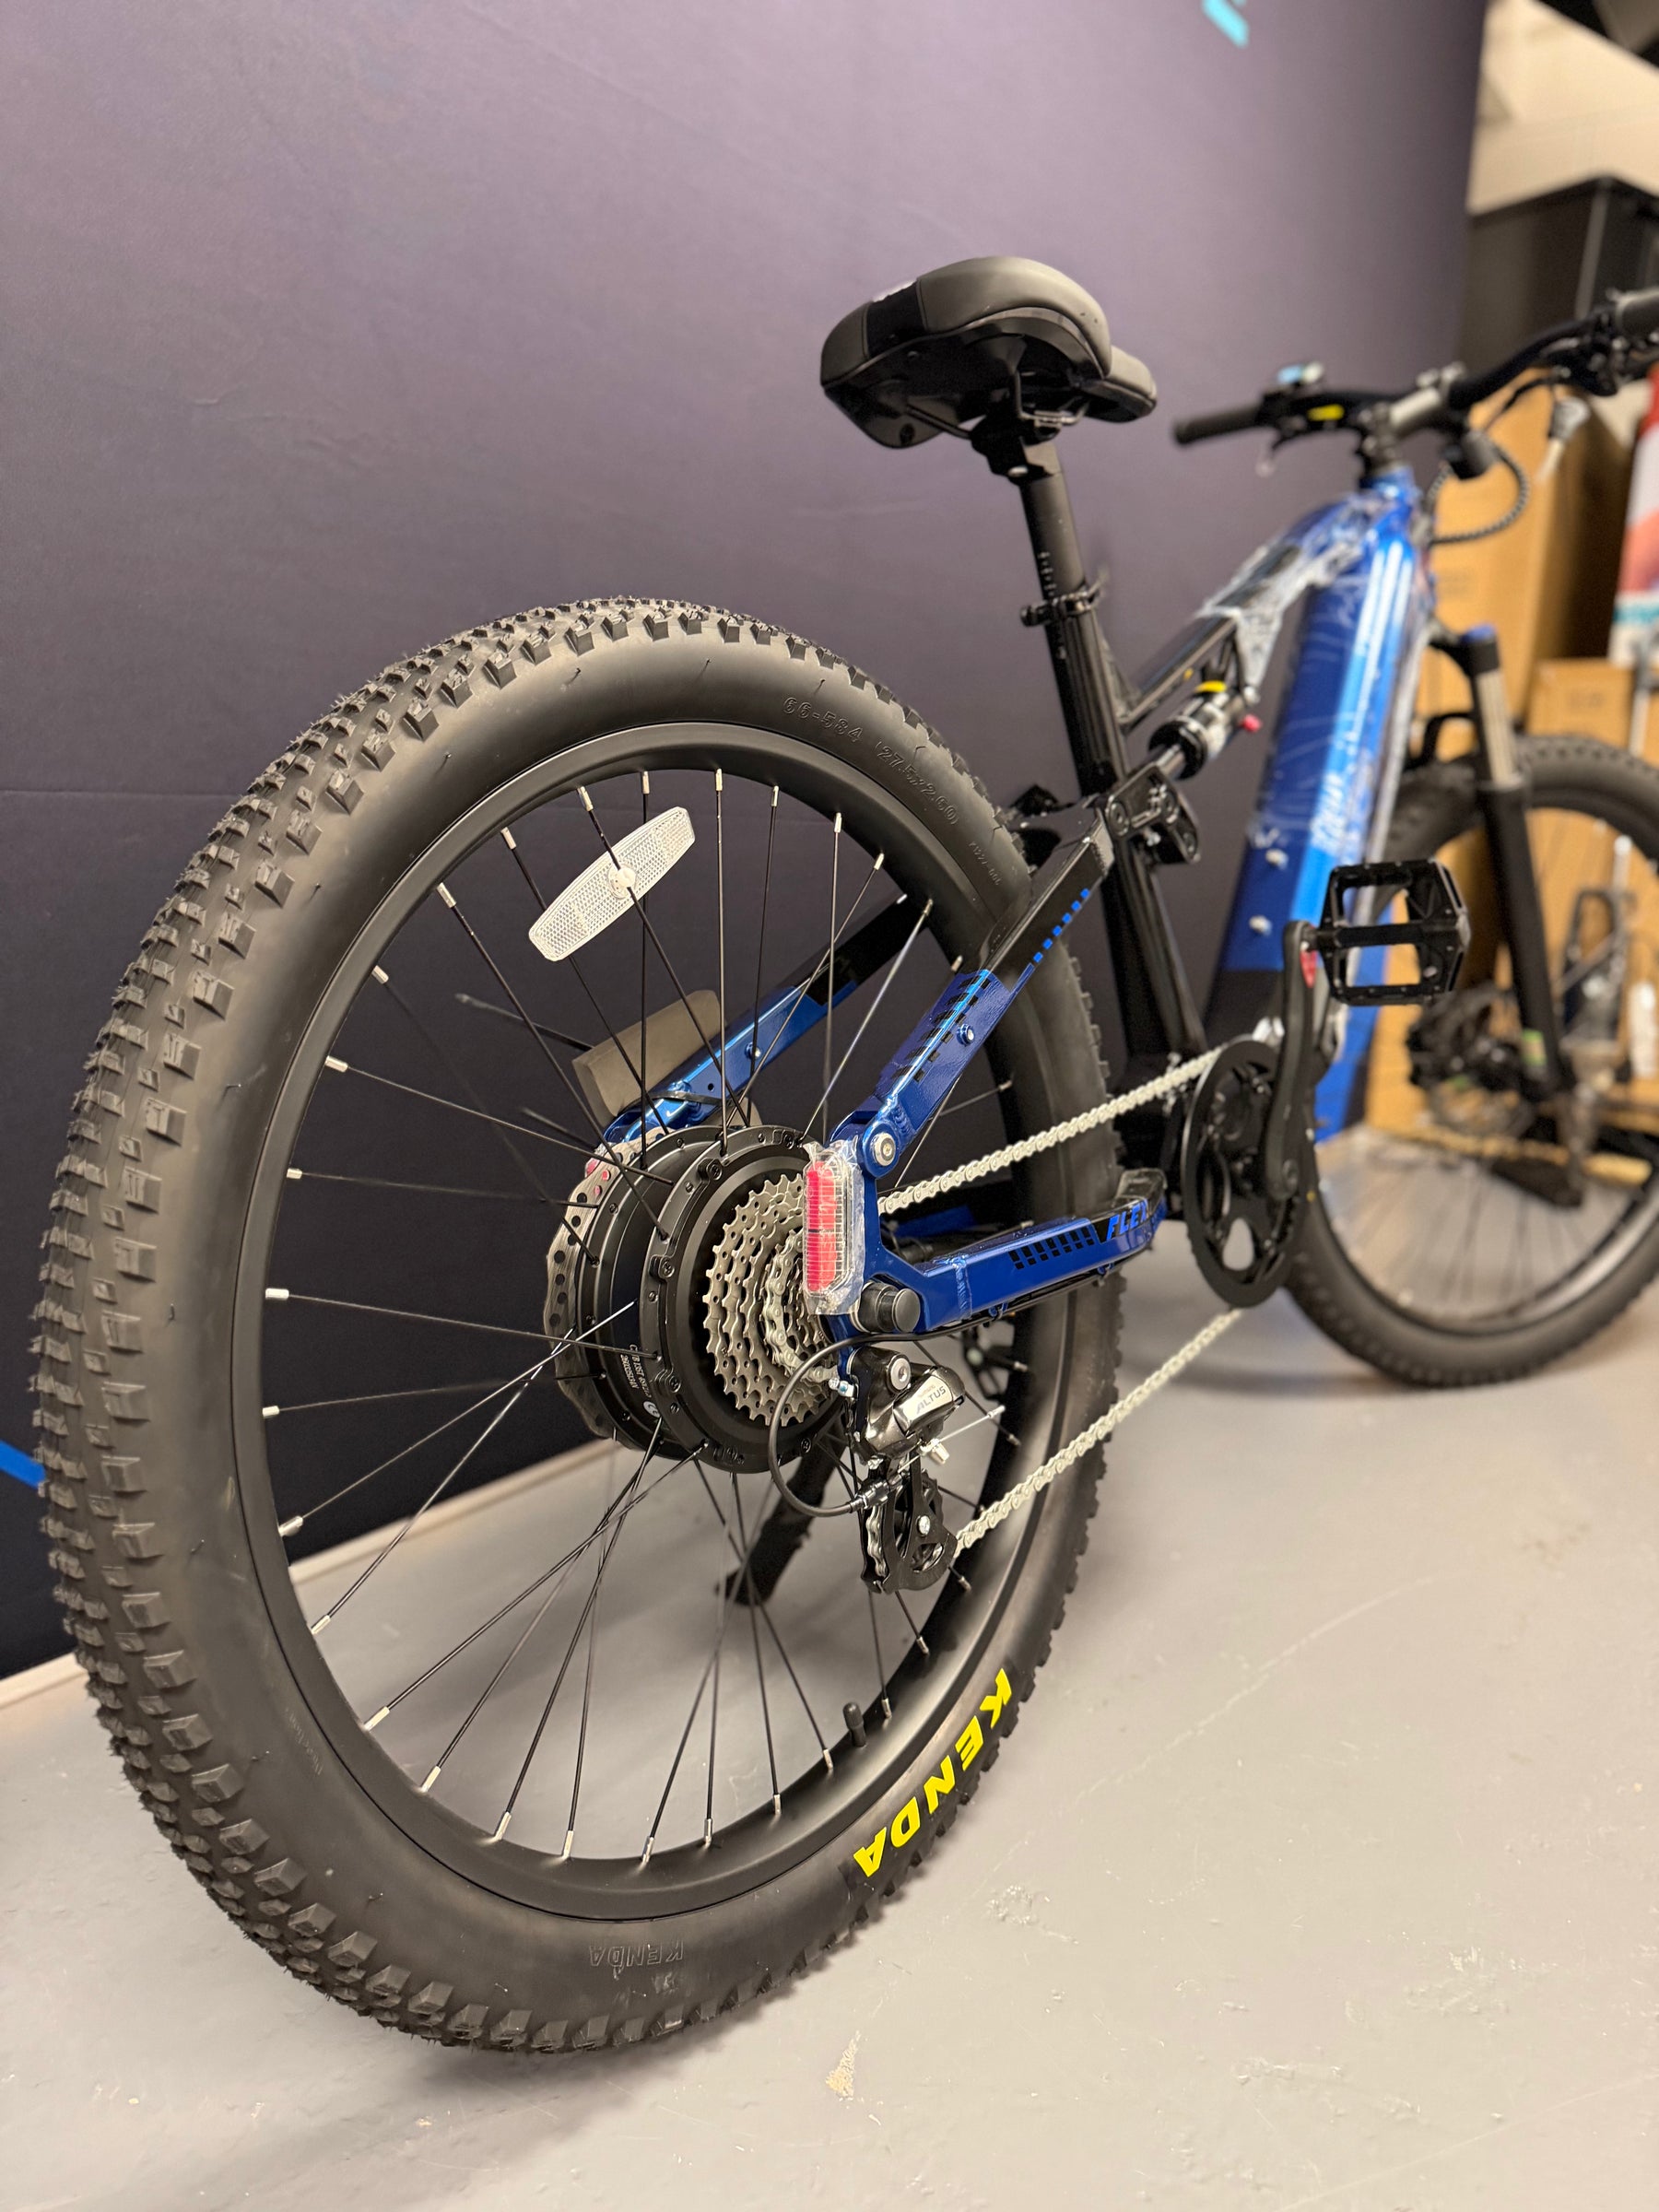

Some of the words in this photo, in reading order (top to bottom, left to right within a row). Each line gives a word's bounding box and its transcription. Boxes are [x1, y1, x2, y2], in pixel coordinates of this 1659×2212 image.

[783, 697, 864, 744] 66-584
[915, 1385, 947, 1415] ALTUS
[853, 1667, 1012, 1877] KENDA
[589, 1939, 684, 1968] KENDA
